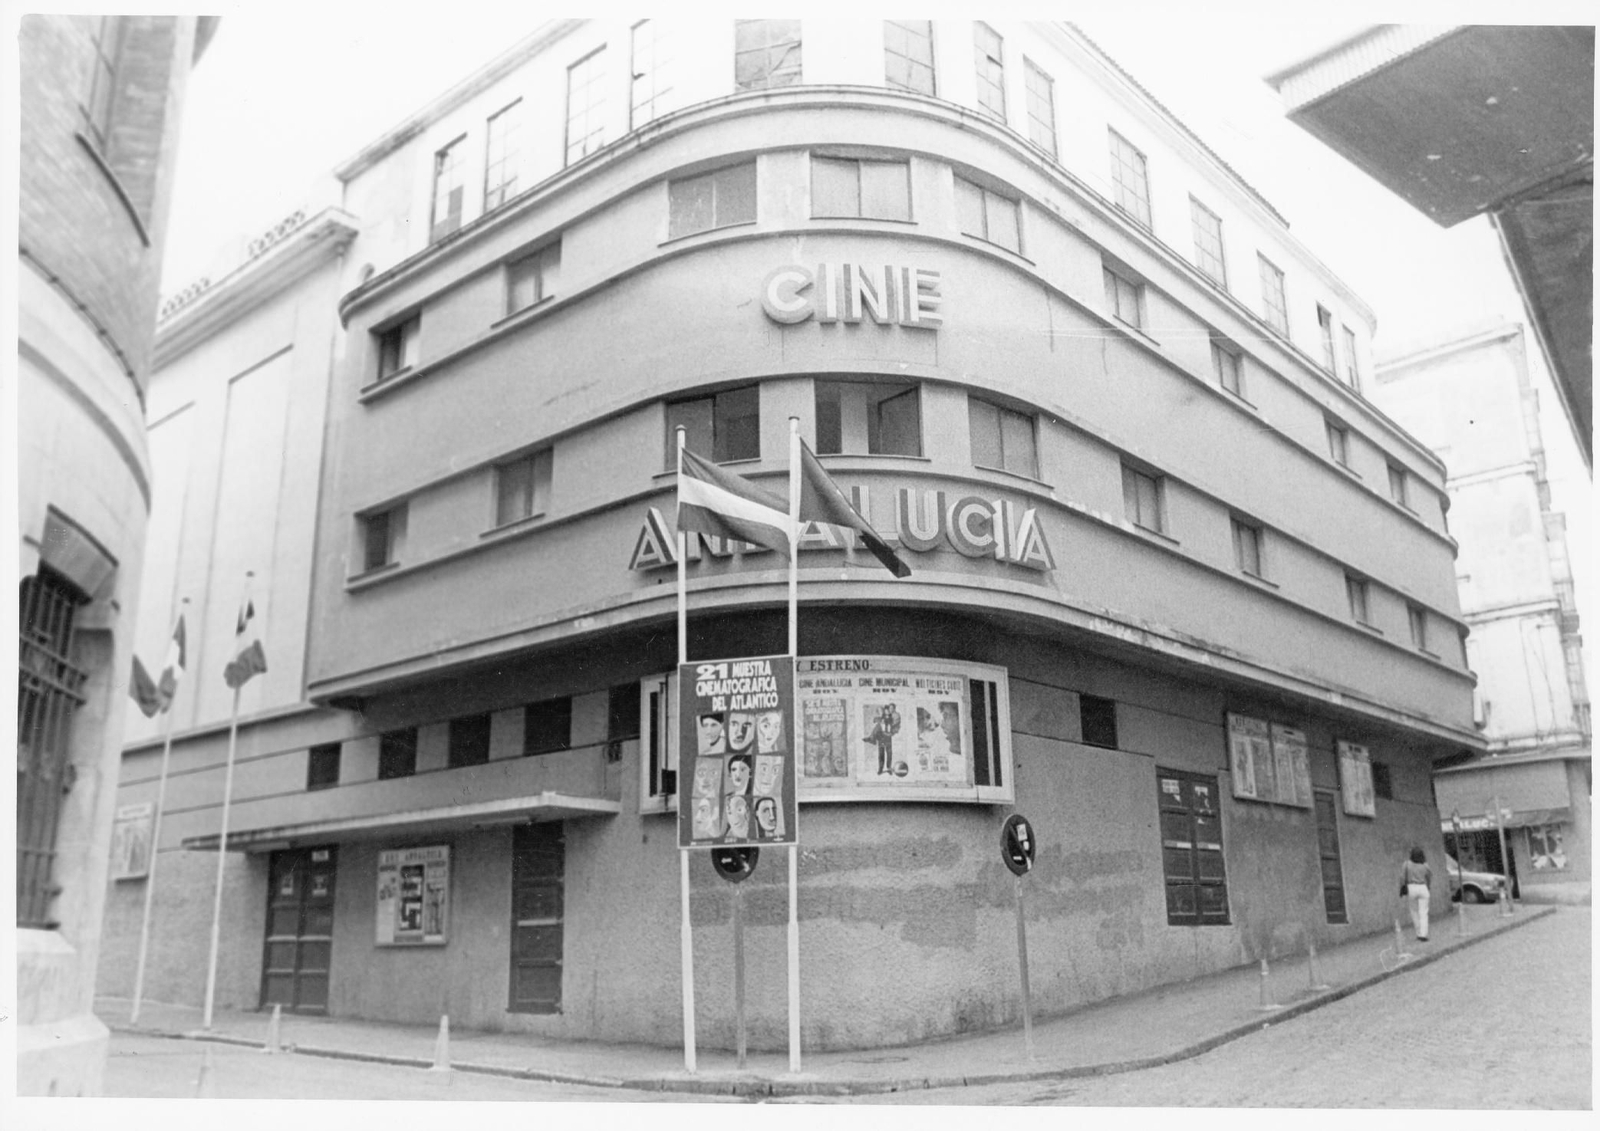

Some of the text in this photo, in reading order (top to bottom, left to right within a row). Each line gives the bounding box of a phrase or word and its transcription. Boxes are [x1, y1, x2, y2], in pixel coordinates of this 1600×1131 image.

[761, 264, 943, 329] CINE
[696, 660, 772, 681] 21 MUESTRA
[810, 659, 870, 672] ESTRENO
[696, 676, 777, 697] CINEMATOGRAFICA
[875, 677, 910, 687] MUNICIPAL
[712, 692, 778, 712] DEL ATLANTICO
